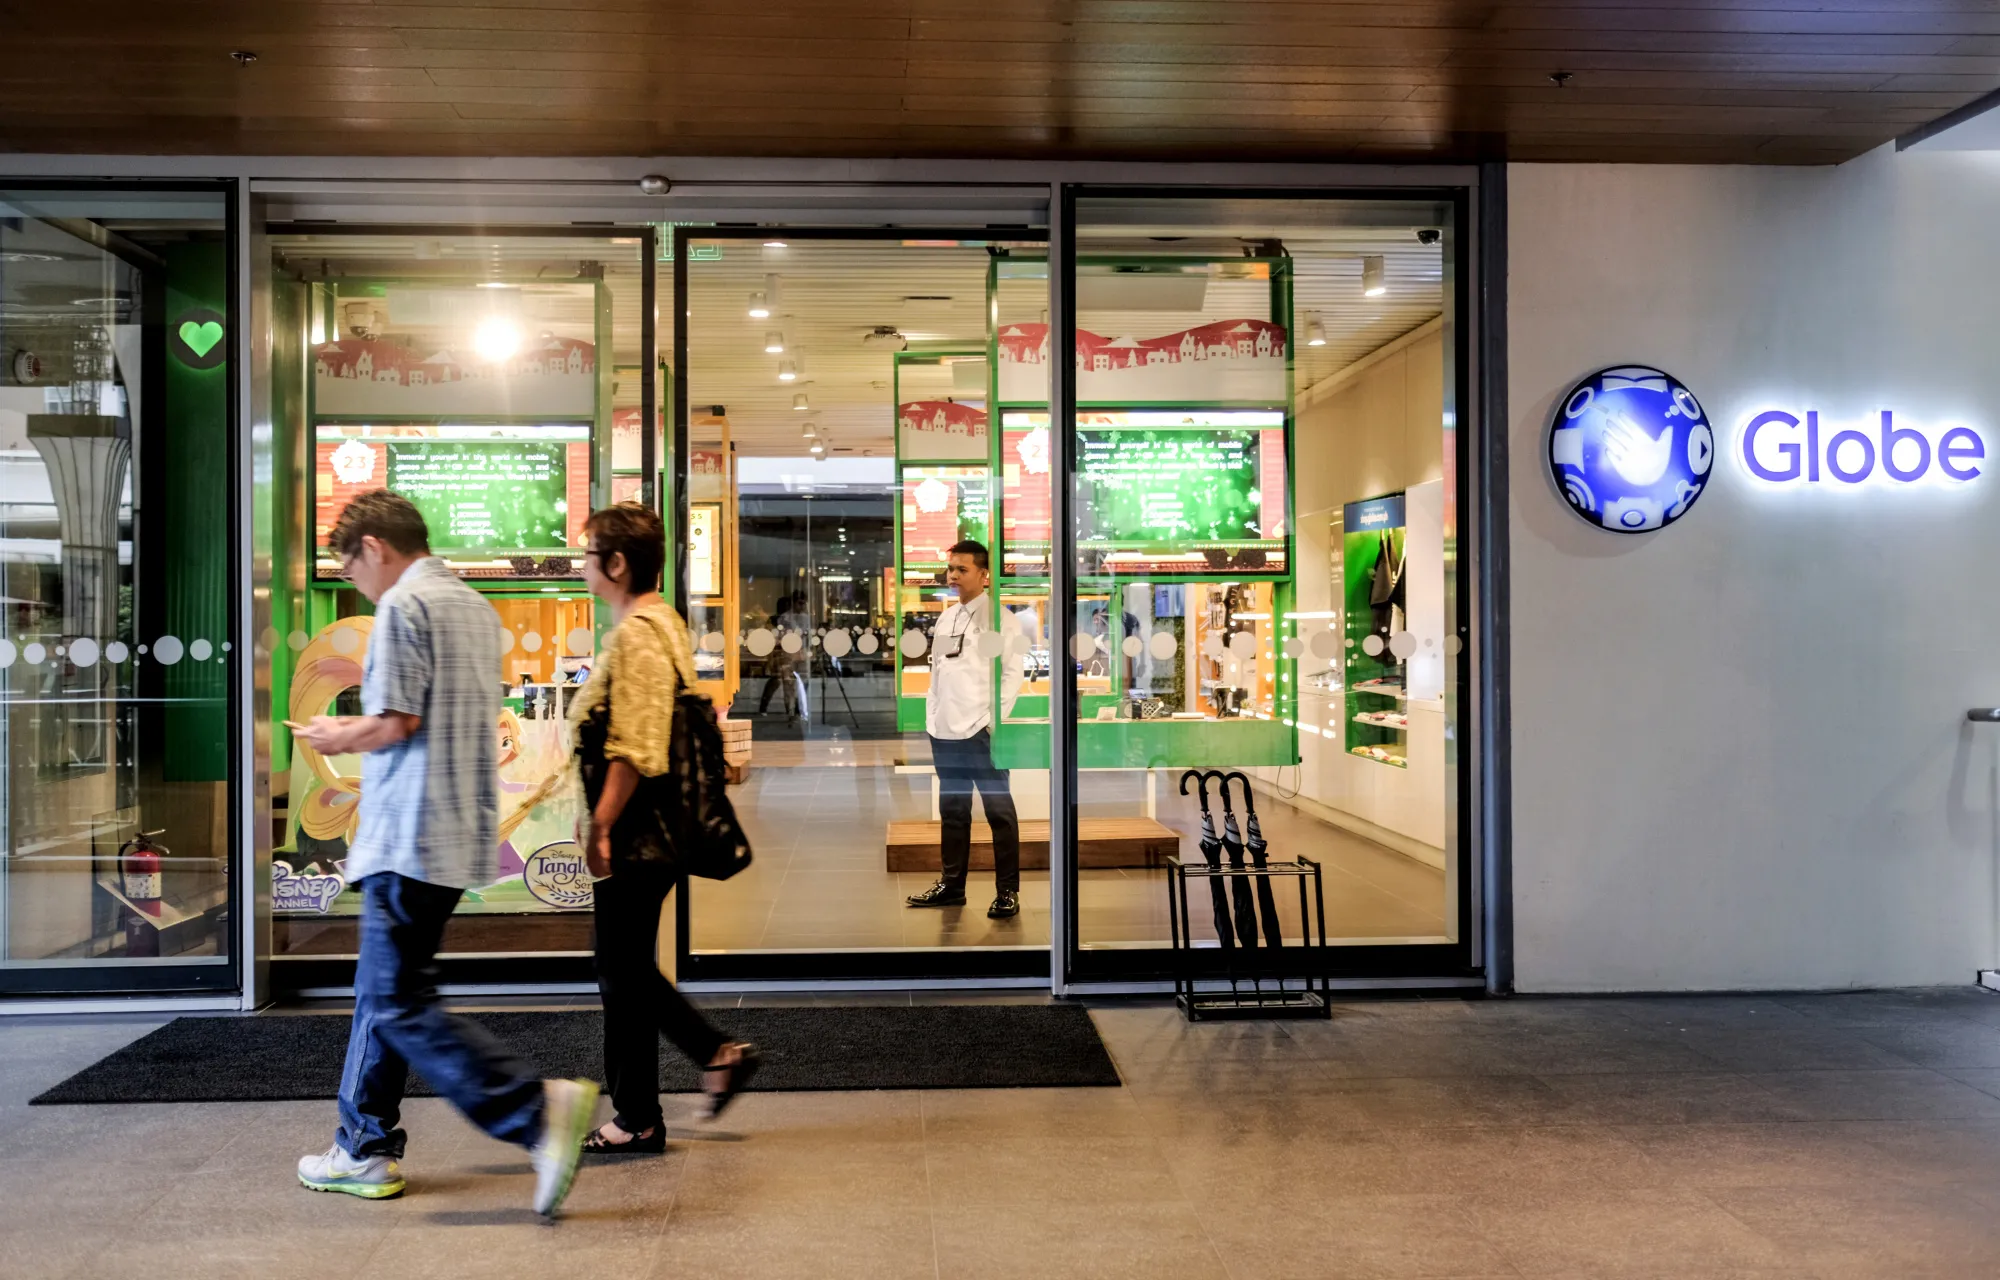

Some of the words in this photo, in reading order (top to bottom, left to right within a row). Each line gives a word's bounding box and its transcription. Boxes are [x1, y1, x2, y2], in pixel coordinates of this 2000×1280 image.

[1743, 410, 1985, 484] Globe
[344, 455, 366, 469] 23
[396, 453, 426, 461] Immerse
[430, 453, 459, 462] yourself
[514, 453, 522, 461] of
[525, 453, 549, 461] mobile
[535, 463, 550, 471] and
[548, 849, 576, 860] Disney
[533, 855, 589, 885] Tangl
